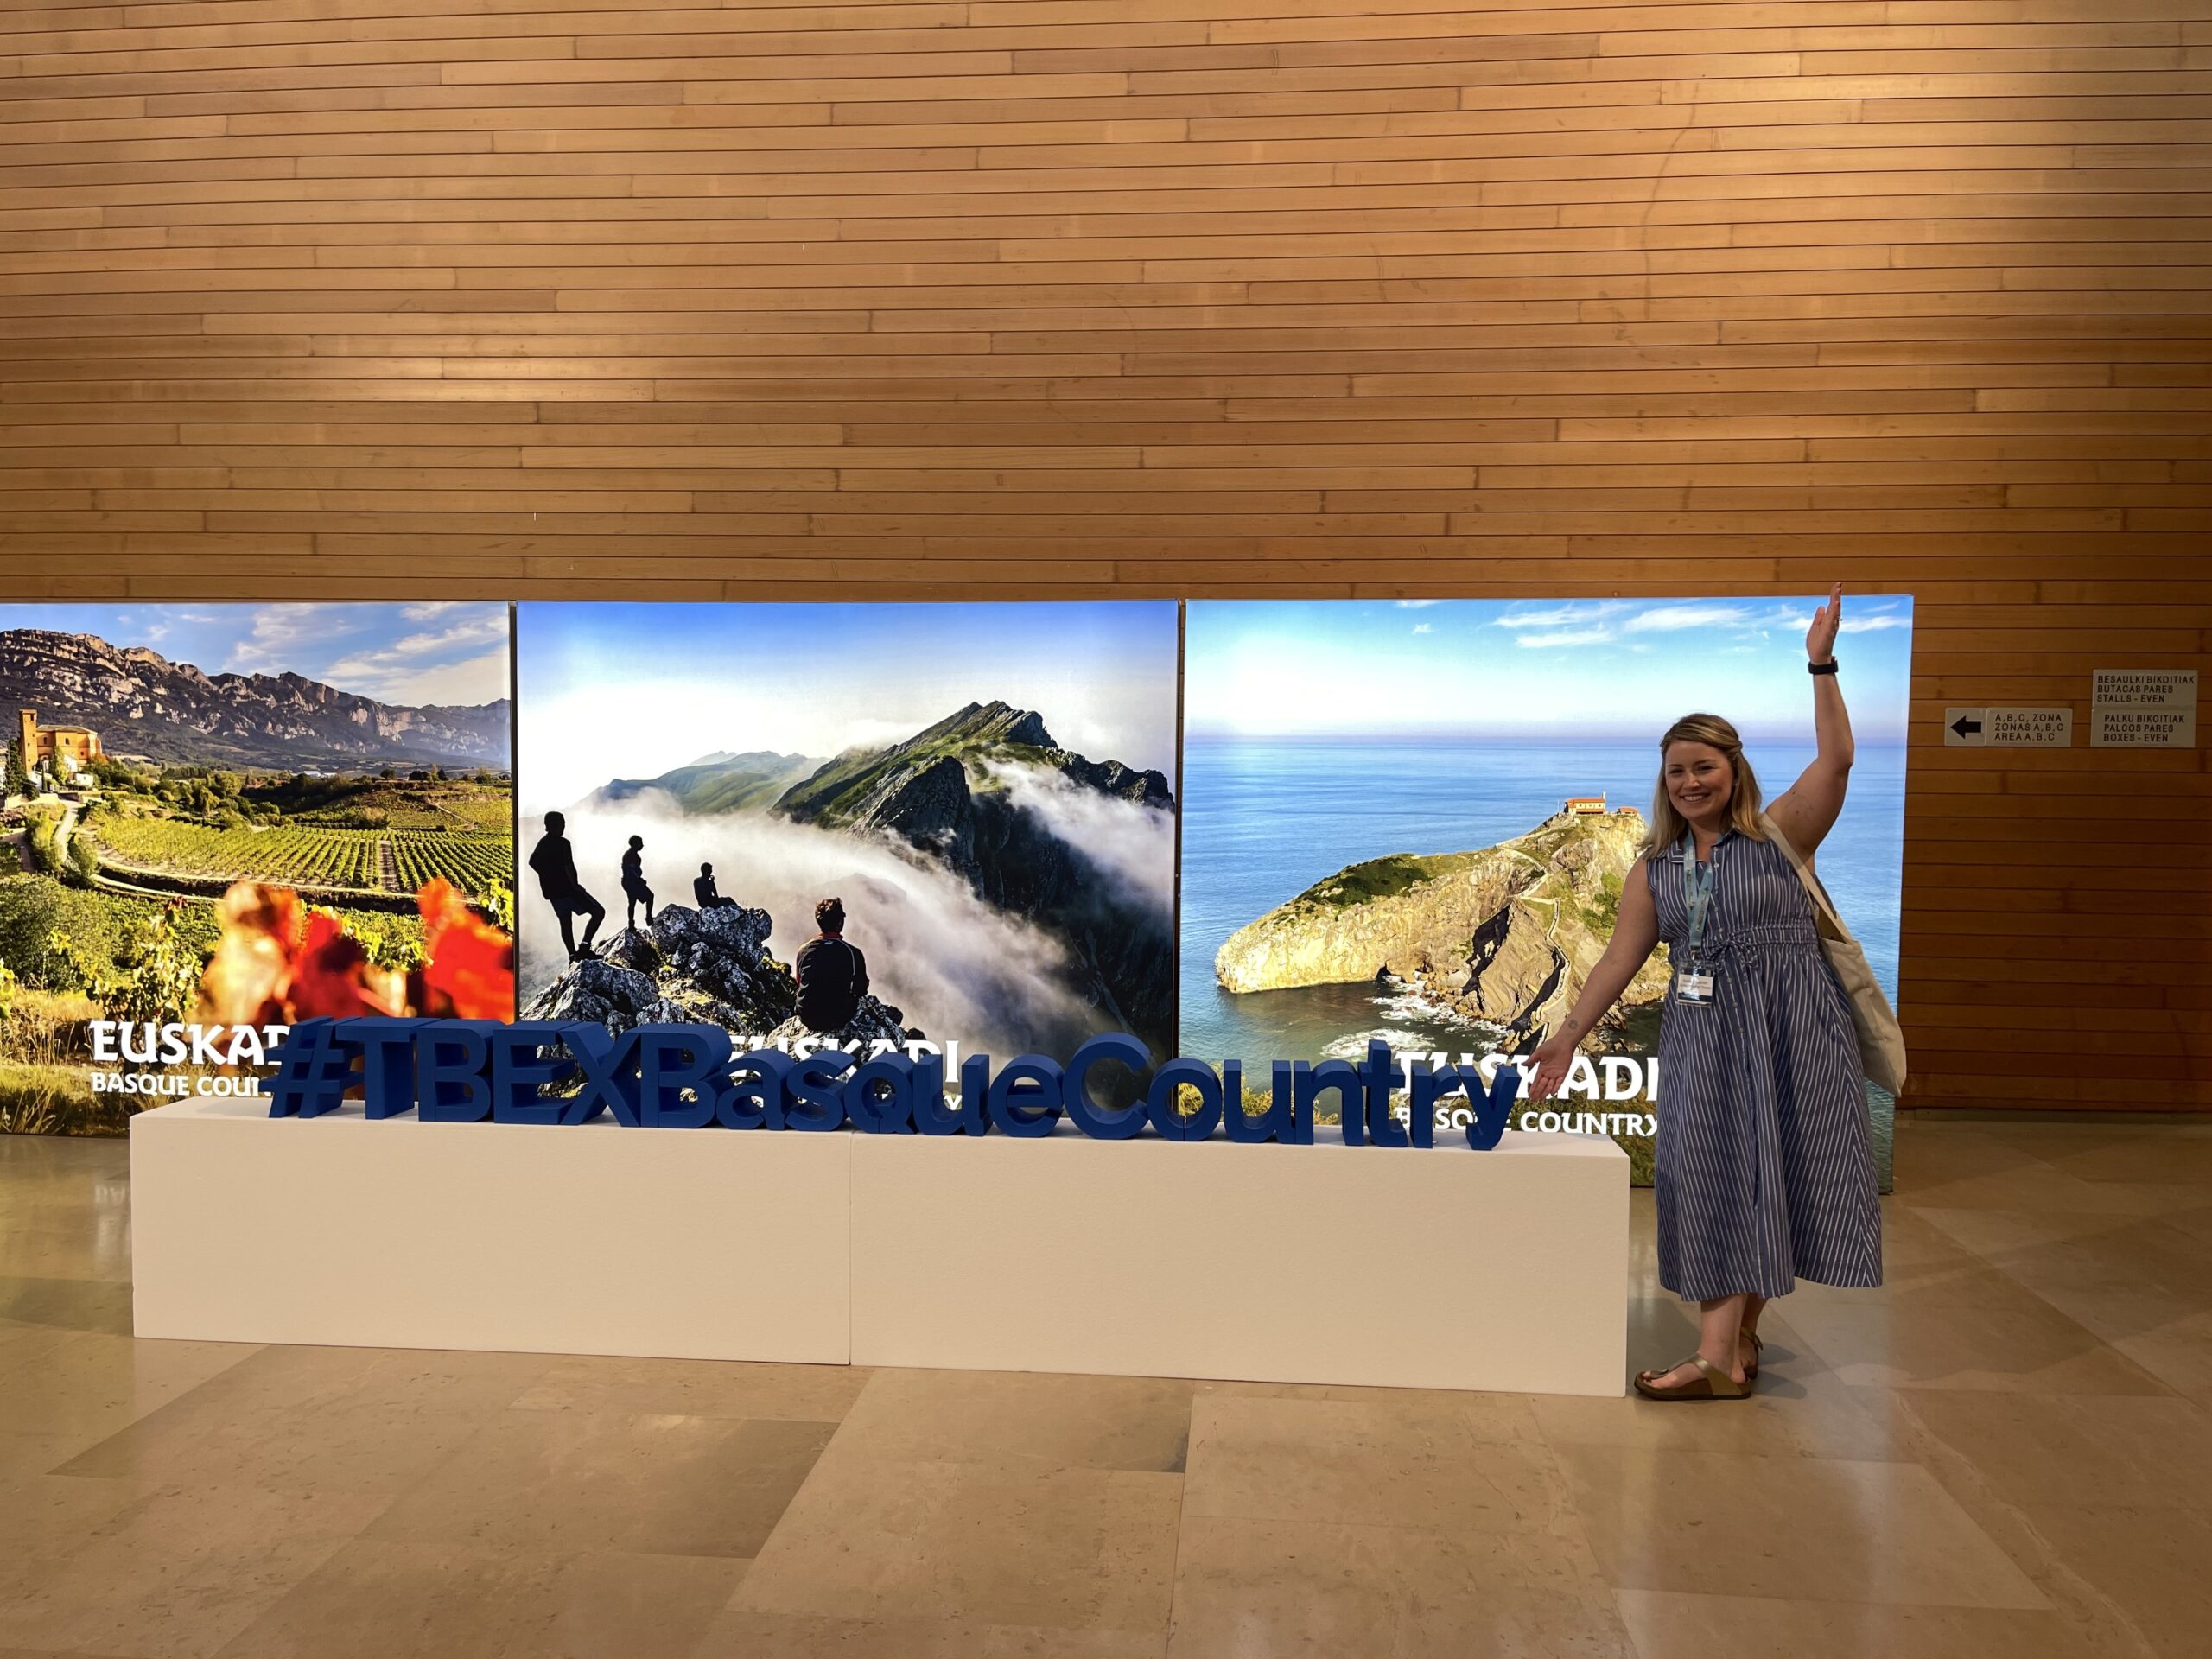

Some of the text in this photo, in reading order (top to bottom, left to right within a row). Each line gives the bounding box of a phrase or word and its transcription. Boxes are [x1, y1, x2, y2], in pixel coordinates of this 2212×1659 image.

[2097, 675, 2196, 684] BESAULKI BIKOITIAK
[2097, 684, 2174, 694] BUTACAS PARES
[2096, 694, 2133, 703] STALLS
[2140, 695, 2165, 703] EVEN
[2032, 713, 2063, 722] ZONA
[2104, 714, 2185, 724] PALKU BIKOITIAK
[1994, 723, 2031, 732] ZONAS
[2103, 724, 2174, 733] PALCOS PARES
[1994, 733, 2023, 741] AREA
[2103, 733, 2136, 742] BOXES
[2143, 734, 2169, 742] EVEN
[89, 1020, 291, 1066] EUSKA
[90, 1071, 190, 1096] BASQUE
[259, 1015, 1520, 1151] #TBEXBasqueCountry
[1520, 1111, 1659, 1137] COUNTRY
